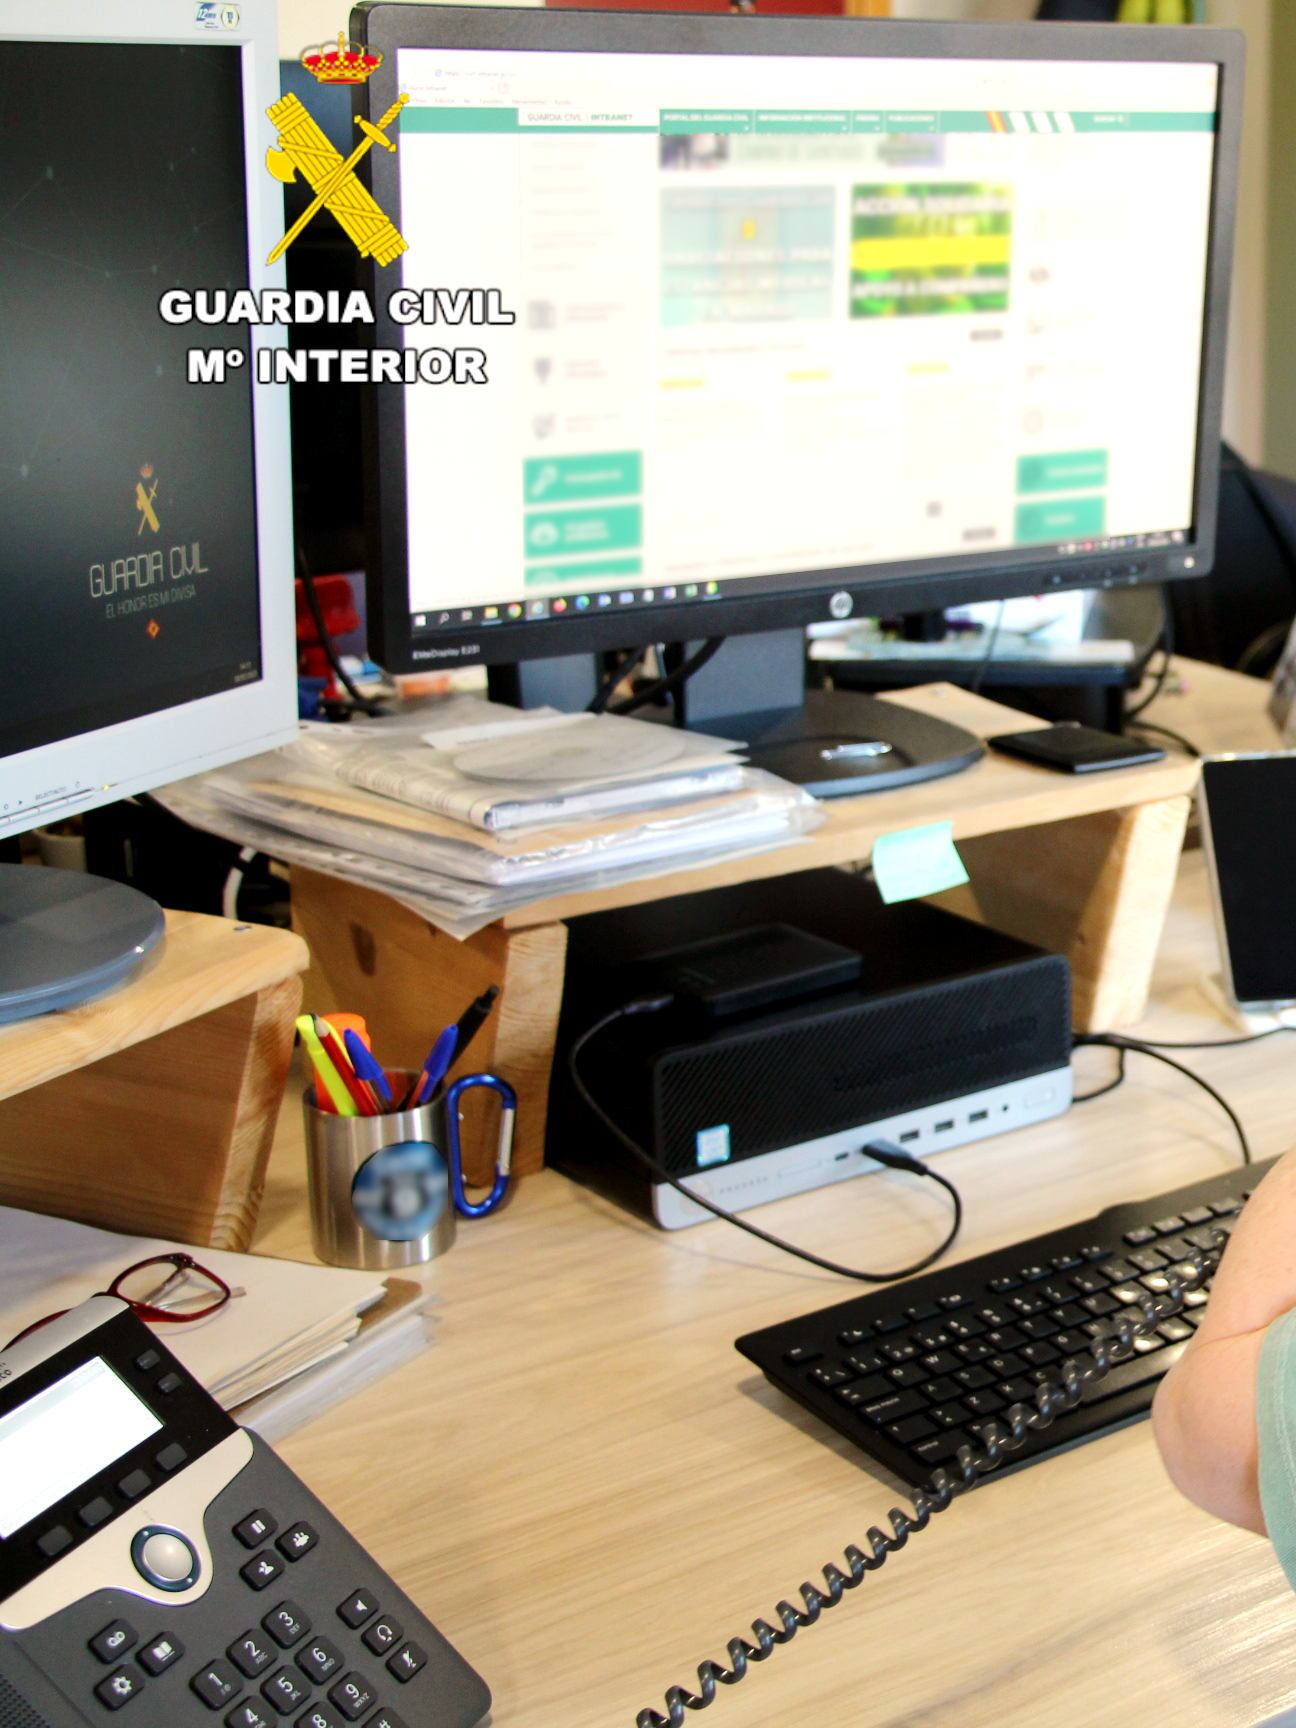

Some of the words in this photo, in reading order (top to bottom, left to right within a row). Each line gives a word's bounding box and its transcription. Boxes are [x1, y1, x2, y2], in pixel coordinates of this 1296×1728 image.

[527, 113, 561, 122] GUARDIA
[89, 550, 164, 598] GUARDIA
[169, 542, 209, 580] CIVIL
[279, 1611, 294, 1626] 3
[244, 1640, 260, 1657] 2
[312, 1647, 327, 1662] 6
[208, 1672, 223, 1686] 1
[278, 1676, 293, 1693] 5
[345, 1683, 360, 1698] 9
[246, 1708, 259, 1723] 4
[312, 1714, 327, 1728] 8
